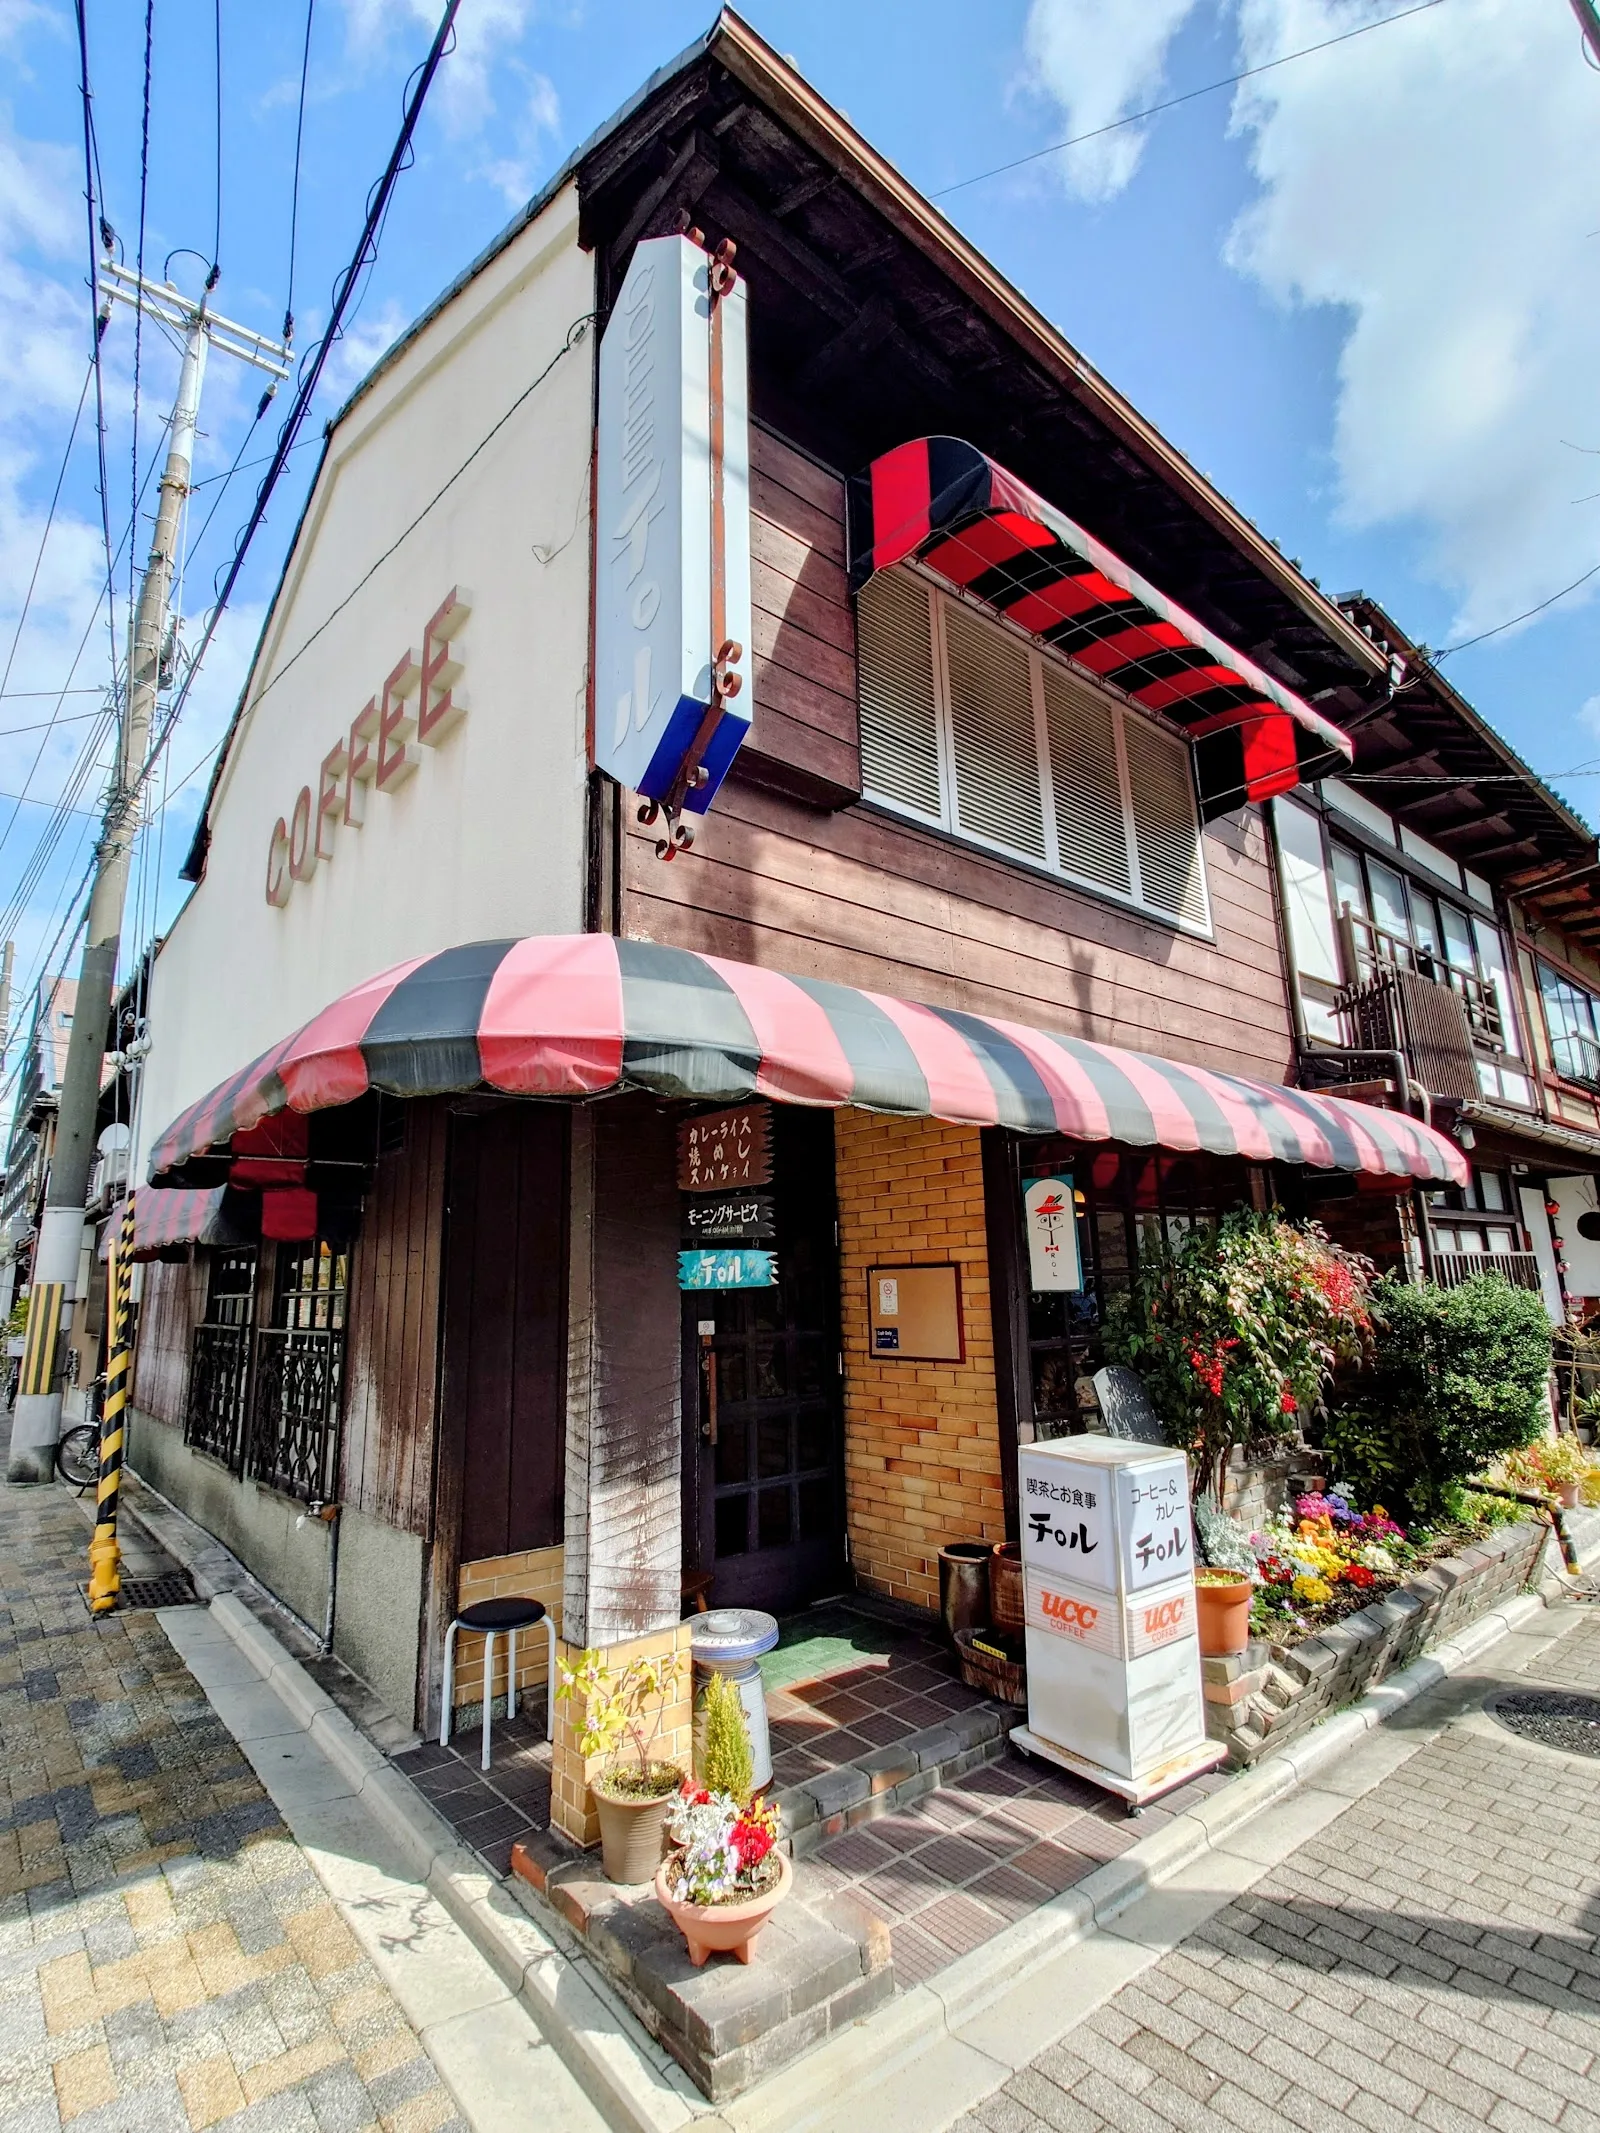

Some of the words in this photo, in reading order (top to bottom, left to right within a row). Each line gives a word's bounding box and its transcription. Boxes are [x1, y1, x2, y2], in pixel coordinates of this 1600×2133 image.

[624, 265, 655, 494] COFFEE
[266, 584, 471, 907] COFFEE
[688, 1116, 752, 1145] カレーライス
[688, 1203, 759, 1226] モーニングサービス
[1026, 1478, 1097, 1509] 喫茶とお食事
[1155, 1502, 1185, 1521] カレー
[1028, 1513, 1099, 1554] チロル
[1135, 1527, 1188, 1571] チロル
[1040, 1591, 1098, 1629] UCC
[1144, 1597, 1185, 1634] UCC
[1050, 1618, 1086, 1639] COFFEE
[1151, 1625, 1178, 1643] COFFEE
